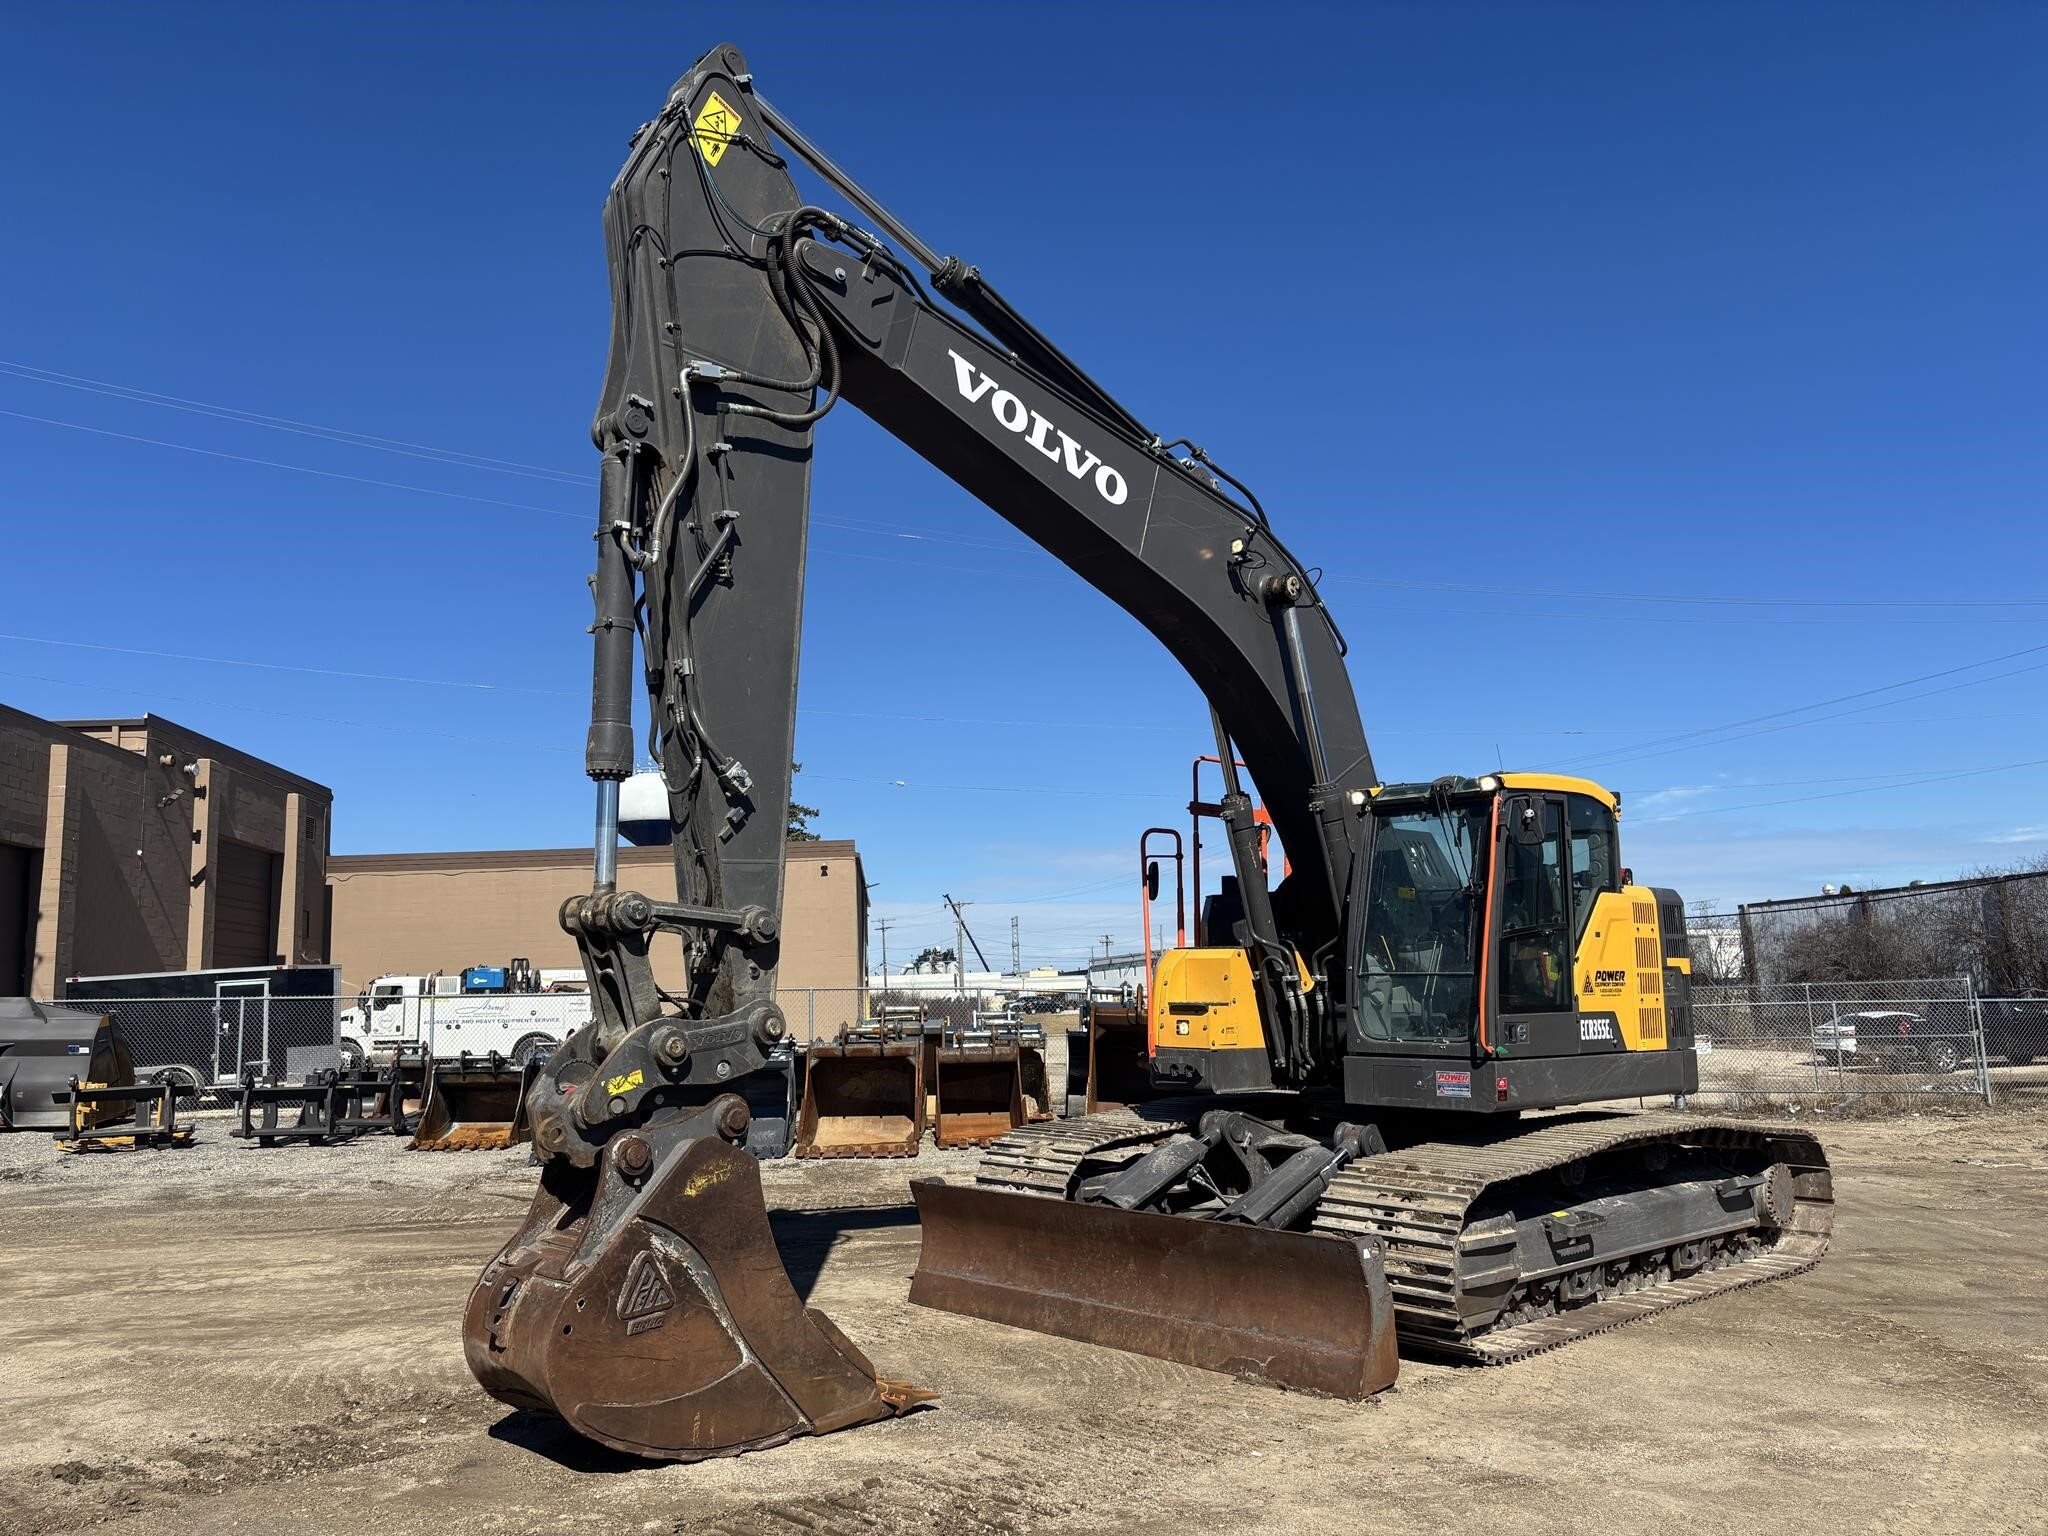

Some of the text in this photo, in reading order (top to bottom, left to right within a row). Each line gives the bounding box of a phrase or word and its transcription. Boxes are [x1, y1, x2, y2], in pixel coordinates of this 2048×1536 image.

[718, 99, 739, 121] WARNING
[947, 347, 1128, 506] VOLVO
[1595, 971, 1625, 981] POWER
[693, 1031, 744, 1047] VOLVO
